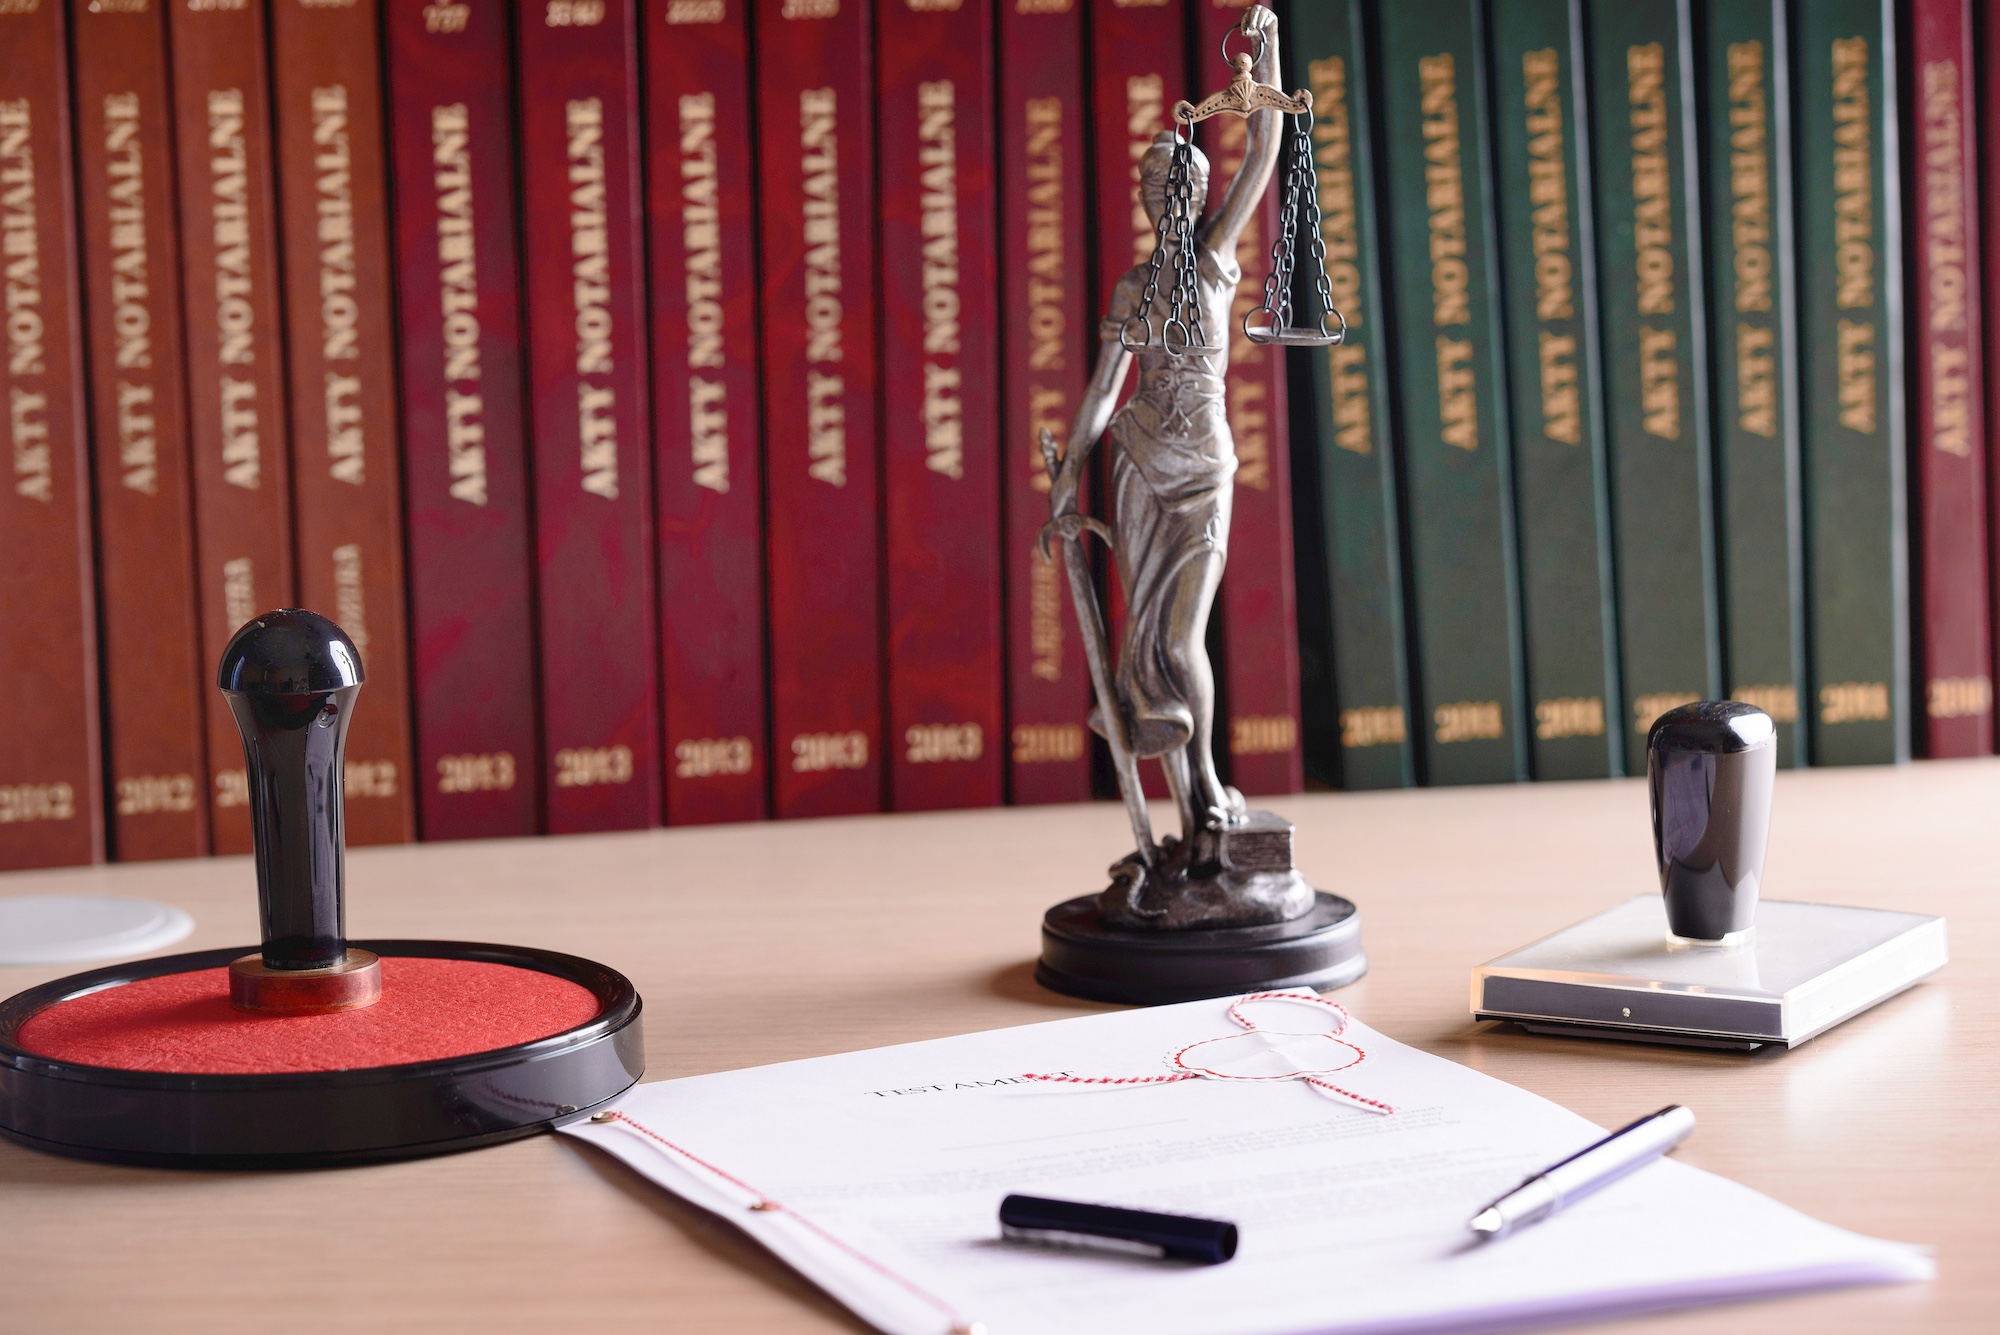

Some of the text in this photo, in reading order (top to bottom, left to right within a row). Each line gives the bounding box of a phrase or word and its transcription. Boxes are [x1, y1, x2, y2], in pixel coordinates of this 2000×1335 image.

[0, 97, 52, 503] AKTY NOTARIALNE
[104, 91, 158, 495] AKTY NOTARIALNE
[207, 88, 261, 491] AKTY NOTARIALNE
[311, 83, 365, 486] AKTY NOTARIALNE
[432, 102, 488, 507] AKTY NOTARIALNE
[566, 96, 620, 501] AKTY NOTARIALNE
[678, 91, 730, 494] AKTY NOTARIALNE
[799, 86, 847, 488] AKTY NOTARIALNE
[918, 79, 964, 480] AKTY NOTARIALNE
[1026, 97, 1065, 372] NOTARIALNE
[1230, 378, 1270, 490] AKTY
[1328, 341, 1371, 454] AKTY
[1418, 52, 1479, 452] AKTY NOTARIALNE
[1523, 48, 1581, 447] AKTY NOTARIALNE
[1626, 41, 1680, 442] AKTY NOTARIALNE
[1727, 39, 1776, 439] AKTY NOTARIALNE
[1831, 35, 1876, 435] AKTY NOTARIALNE
[1924, 60, 1973, 460] AKTY NOTARIALNE
[118, 773, 196, 816] 2012
[437, 752, 515, 794] 2013
[555, 745, 633, 788] 2013
[675, 737, 752, 779] 2013
[791, 732, 868, 773] 2013
[906, 723, 983, 764] 2013
[863, 1070, 1075, 1098] TESTAMET
